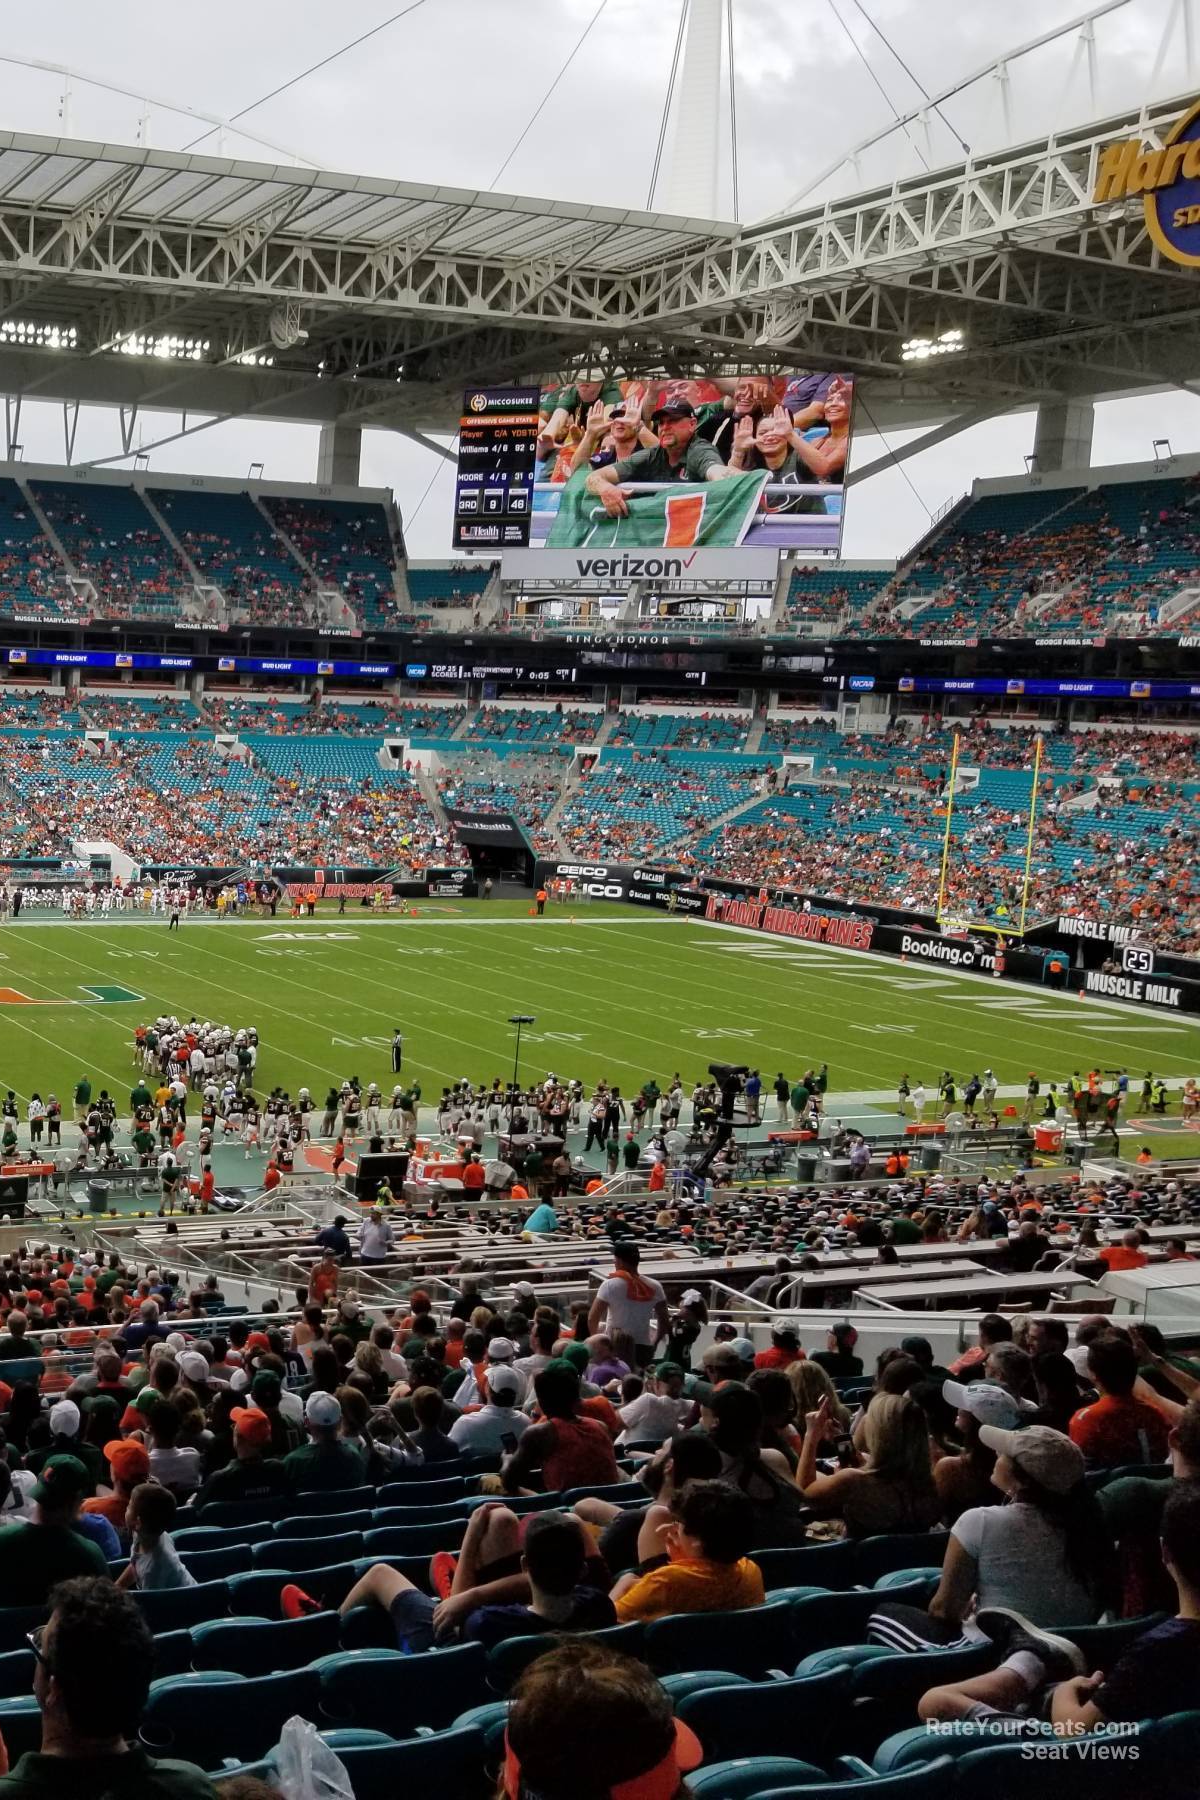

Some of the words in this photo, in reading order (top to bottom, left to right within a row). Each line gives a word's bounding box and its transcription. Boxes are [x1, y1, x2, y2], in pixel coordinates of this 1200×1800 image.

[488, 398, 533, 406] MICCOSUKEE
[461, 431, 484, 440] Player
[460, 445, 488, 454] Williams
[458, 473, 483, 482] MOORE
[459, 500, 477, 509] 3RD
[576, 554, 682, 577] verizon
[829, 560, 847, 568] 327
[566, 635, 601, 644] RING
[616, 635, 669, 644] HONOR
[70, 655, 87, 663] LIGHT
[174, 659, 191, 667] LIGHT
[529, 671, 550, 680] 0:05
[852, 679, 874, 688] NCAA
[957, 682, 975, 690] LIGHT
[1059, 684, 1073, 692] BUD
[1074, 685, 1094, 693] LIGHT
[557, 865, 607, 877] GEICO
[677, 896, 702, 907] Mortgage
[763, 907, 874, 950] HURRIANES
[1058, 917, 1107, 940] MUSCLE
[901, 936, 996, 970] Booking.cm
[1127, 951, 1149, 971] 25
[1087, 972, 1142, 1000] MUSCLE
[1145, 983, 1182, 1006] MILK
[507, 1032, 581, 1043] 30
[679, 1027, 751, 1039] 20
